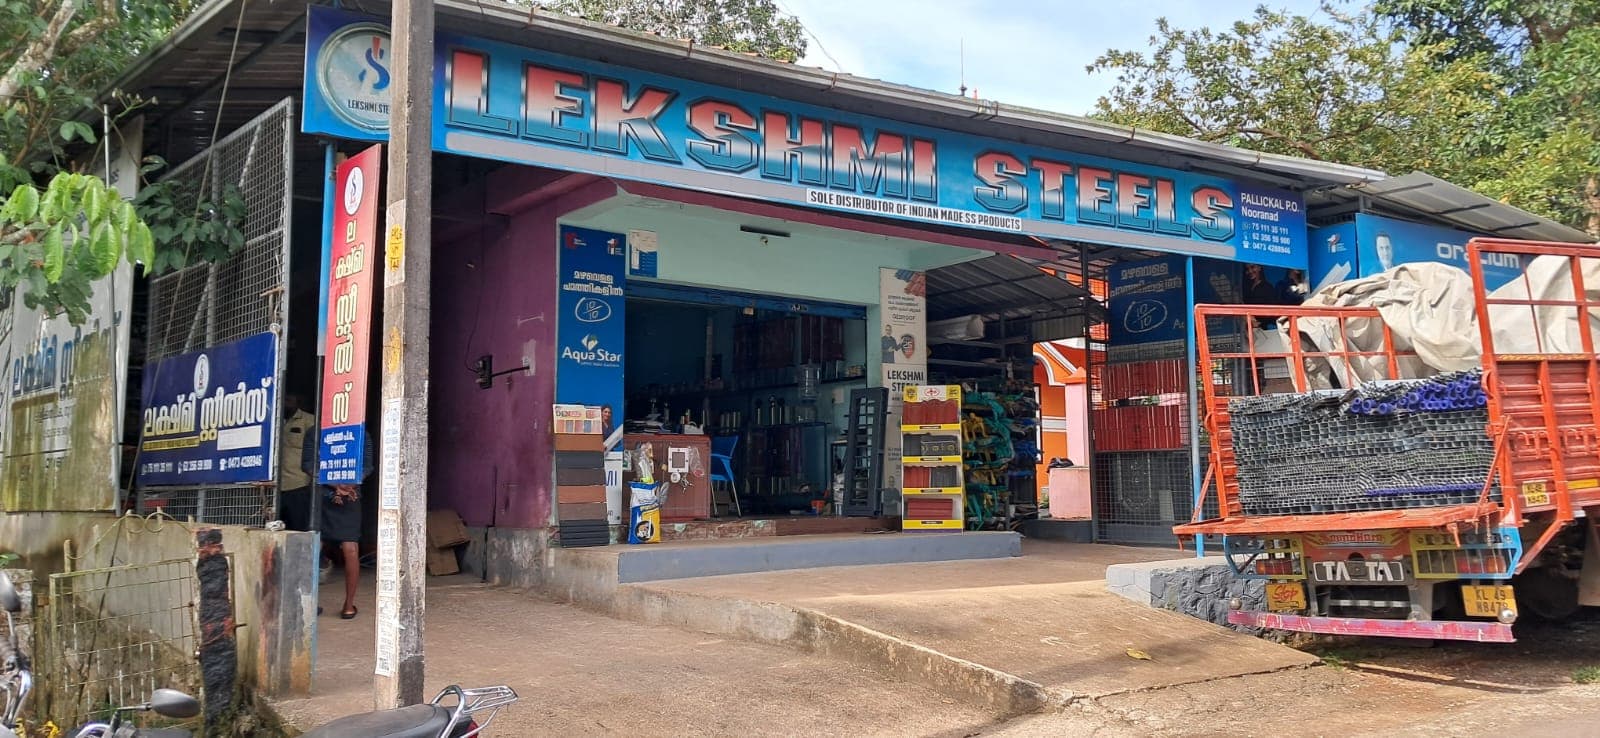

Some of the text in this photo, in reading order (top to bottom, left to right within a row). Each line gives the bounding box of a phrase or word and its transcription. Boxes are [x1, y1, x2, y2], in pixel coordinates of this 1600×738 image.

[347, 99, 390, 114] LEKSHMI STE
[443, 47, 1236, 242] LEKSHMI STEELS
[1240, 192, 1285, 210] PALLICKAL
[810, 190, 1021, 230] SOLE DISTRIBUTOR OF INDIAN MADE SS PRODUCTS
[1241, 206, 1279, 222] Nooranad
[1436, 242, 1520, 269] orium
[561, 346, 623, 363] Aqua Star
[887, 369, 924, 381] LEKSHMI
[891, 382, 920, 392] STE
[1322, 561, 1394, 582] TATA
[1475, 589, 1506, 600] KL 49
